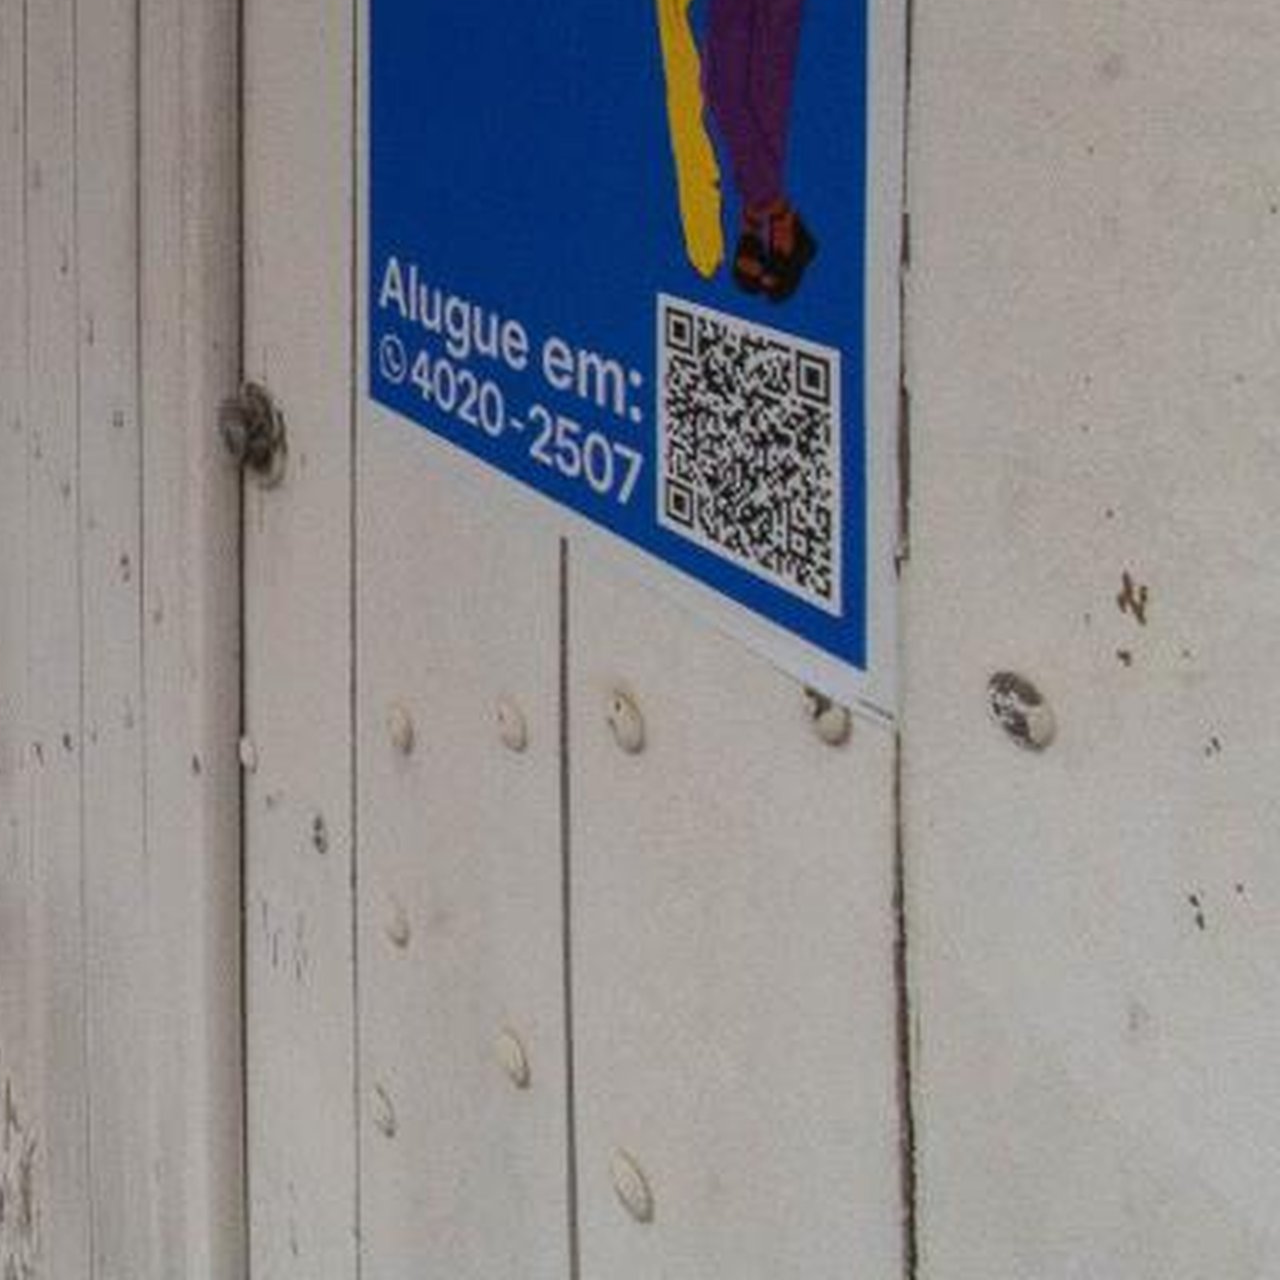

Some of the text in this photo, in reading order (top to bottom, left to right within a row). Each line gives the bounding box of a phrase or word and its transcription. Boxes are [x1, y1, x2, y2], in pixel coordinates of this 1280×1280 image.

[379, 255, 643, 422] Alugue em:
[411, 349, 643, 504] 4020-2507
